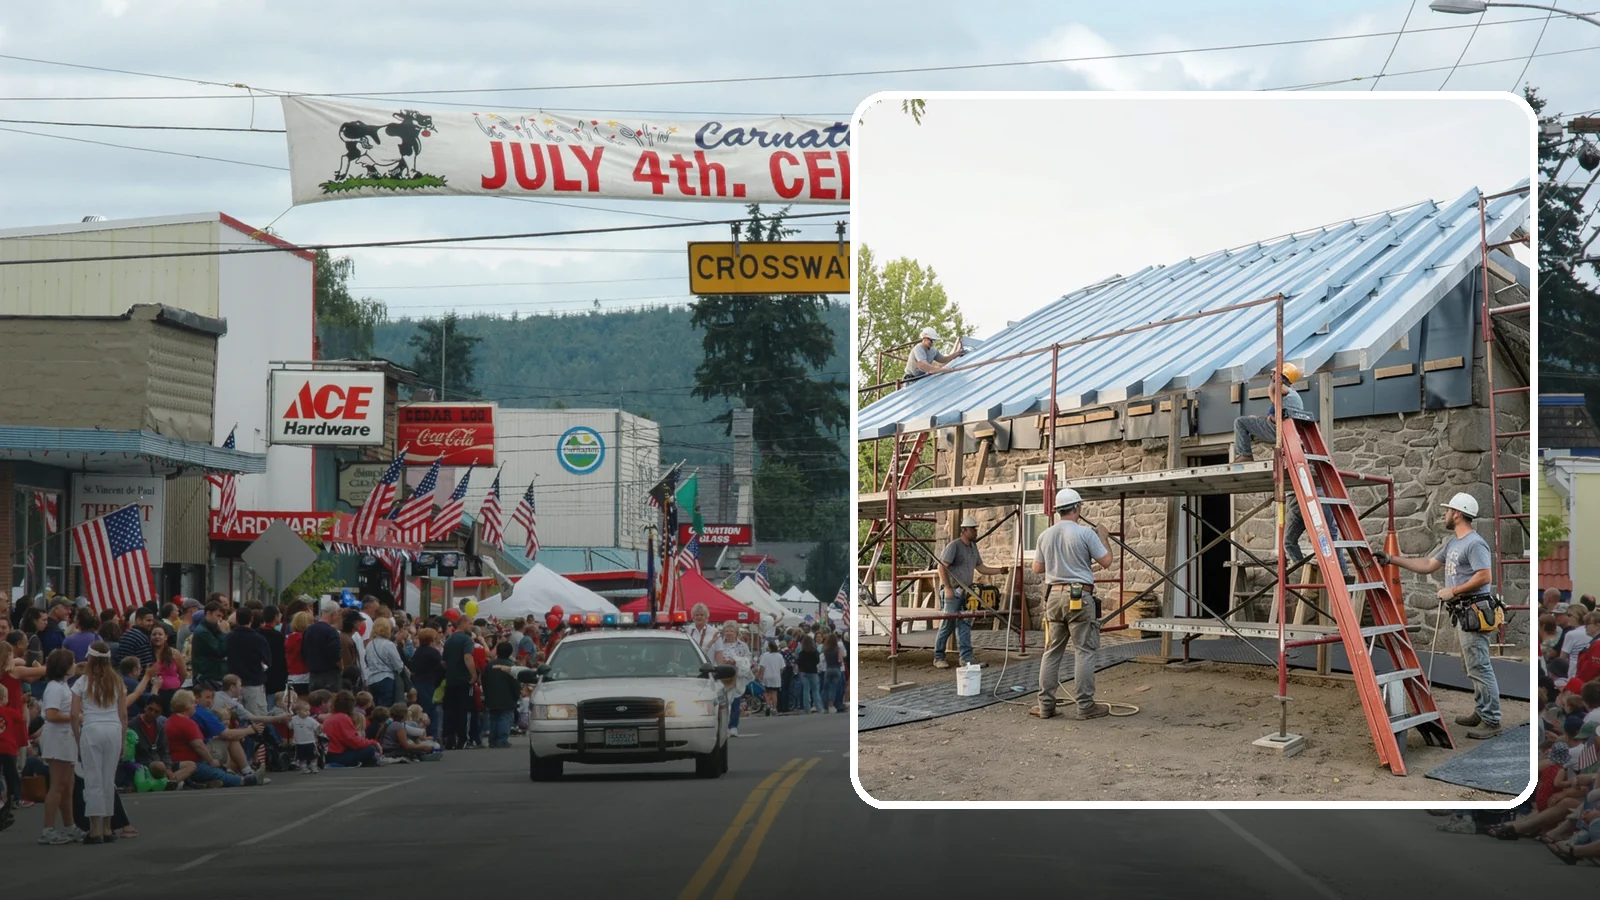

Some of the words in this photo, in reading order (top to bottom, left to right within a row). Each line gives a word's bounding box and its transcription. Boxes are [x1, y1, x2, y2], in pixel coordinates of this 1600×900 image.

[481, 141, 605, 192] JULY
[632, 150, 747, 198] 4th.
[696, 254, 850, 280] CROSSWA
[282, 379, 374, 420] ACE
[405, 409, 453, 422] CEDAR
[283, 421, 371, 437] Hardware
[416, 428, 477, 447] Coca-Cola
[353, 467, 385, 478] Simpl
[83, 485, 94, 494] St.
[95, 485, 124, 495] Vincent
[126, 485, 136, 495] de
[137, 486, 155, 495] Paul
[212, 516, 331, 536] HARDARE
[688, 526, 741, 535] CRNATION
[699, 535, 730, 543] GLASS
